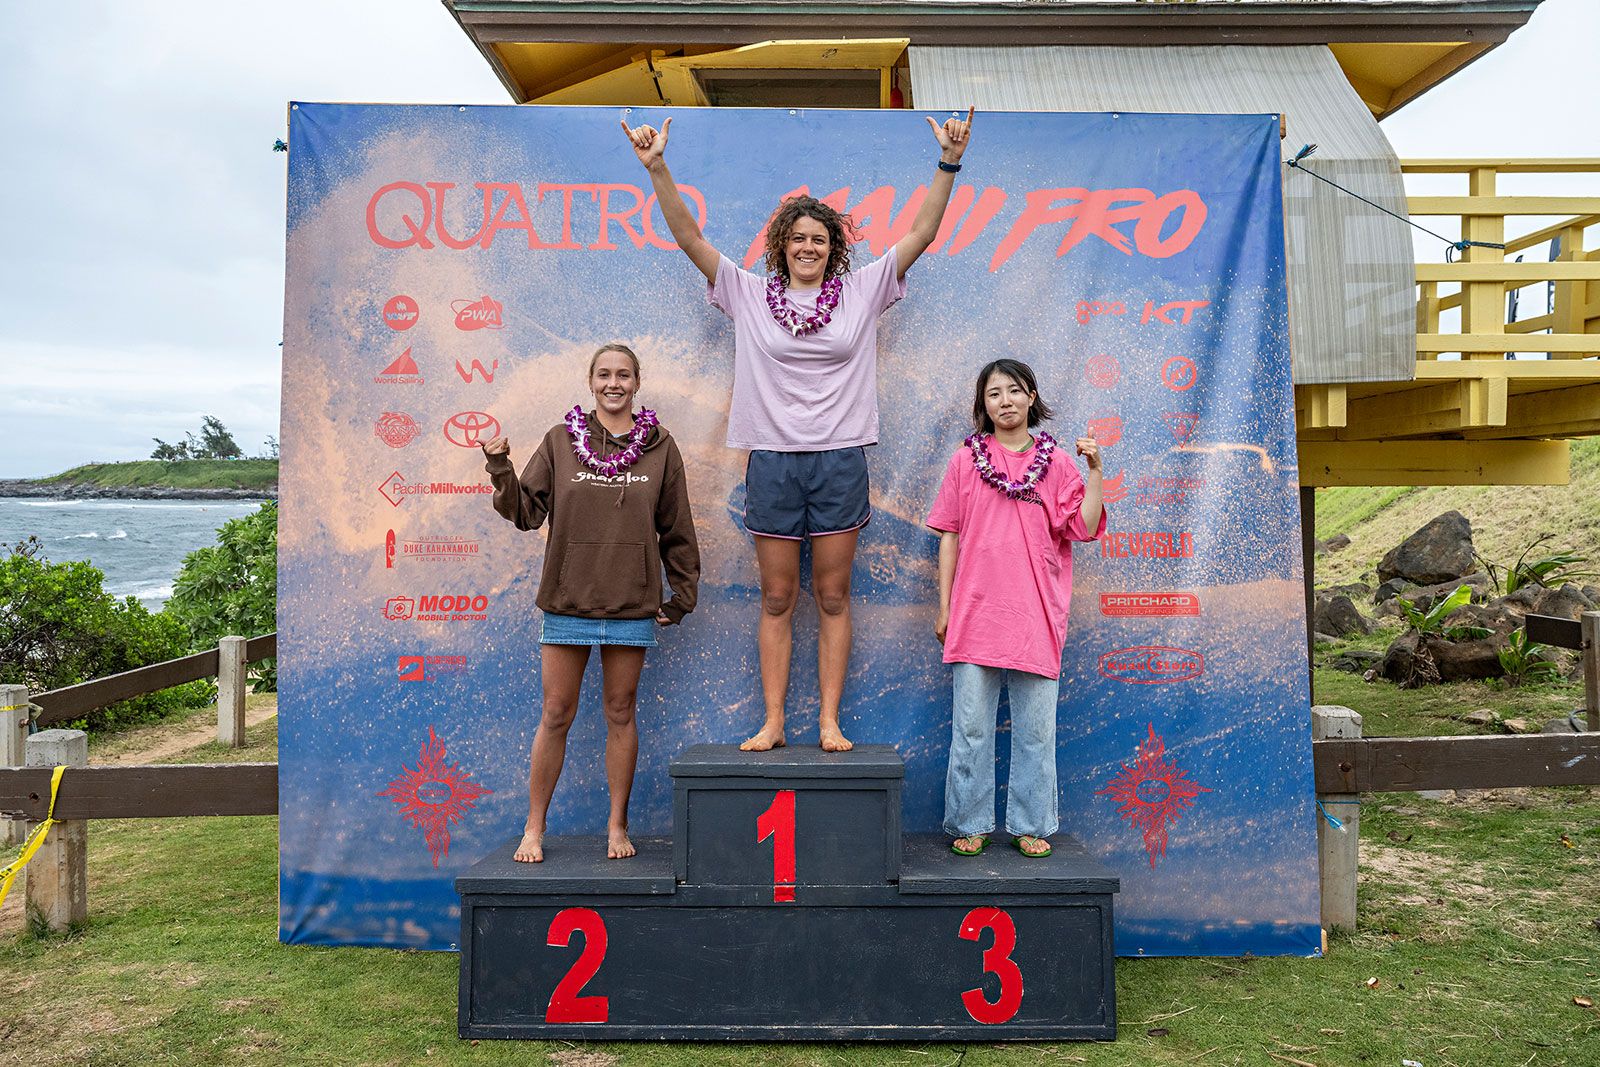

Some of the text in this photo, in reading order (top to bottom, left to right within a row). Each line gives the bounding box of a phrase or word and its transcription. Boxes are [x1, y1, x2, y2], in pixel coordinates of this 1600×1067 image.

[366, 181, 707, 250] QUATRO
[989, 187, 1208, 273] PRO
[461, 309, 497, 321] PWA
[1140, 300, 1211, 325] KT
[374, 377, 424, 385] World Sailing
[404, 544, 479, 553] DUKE KAHANAMOKU
[419, 595, 488, 612] MODO
[1107, 597, 1191, 606] PRITCHARD
[1156, 661, 1196, 671] Store
[757, 789, 796, 903] 1
[545, 907, 610, 1024] 2
[958, 907, 1024, 1024] 3
